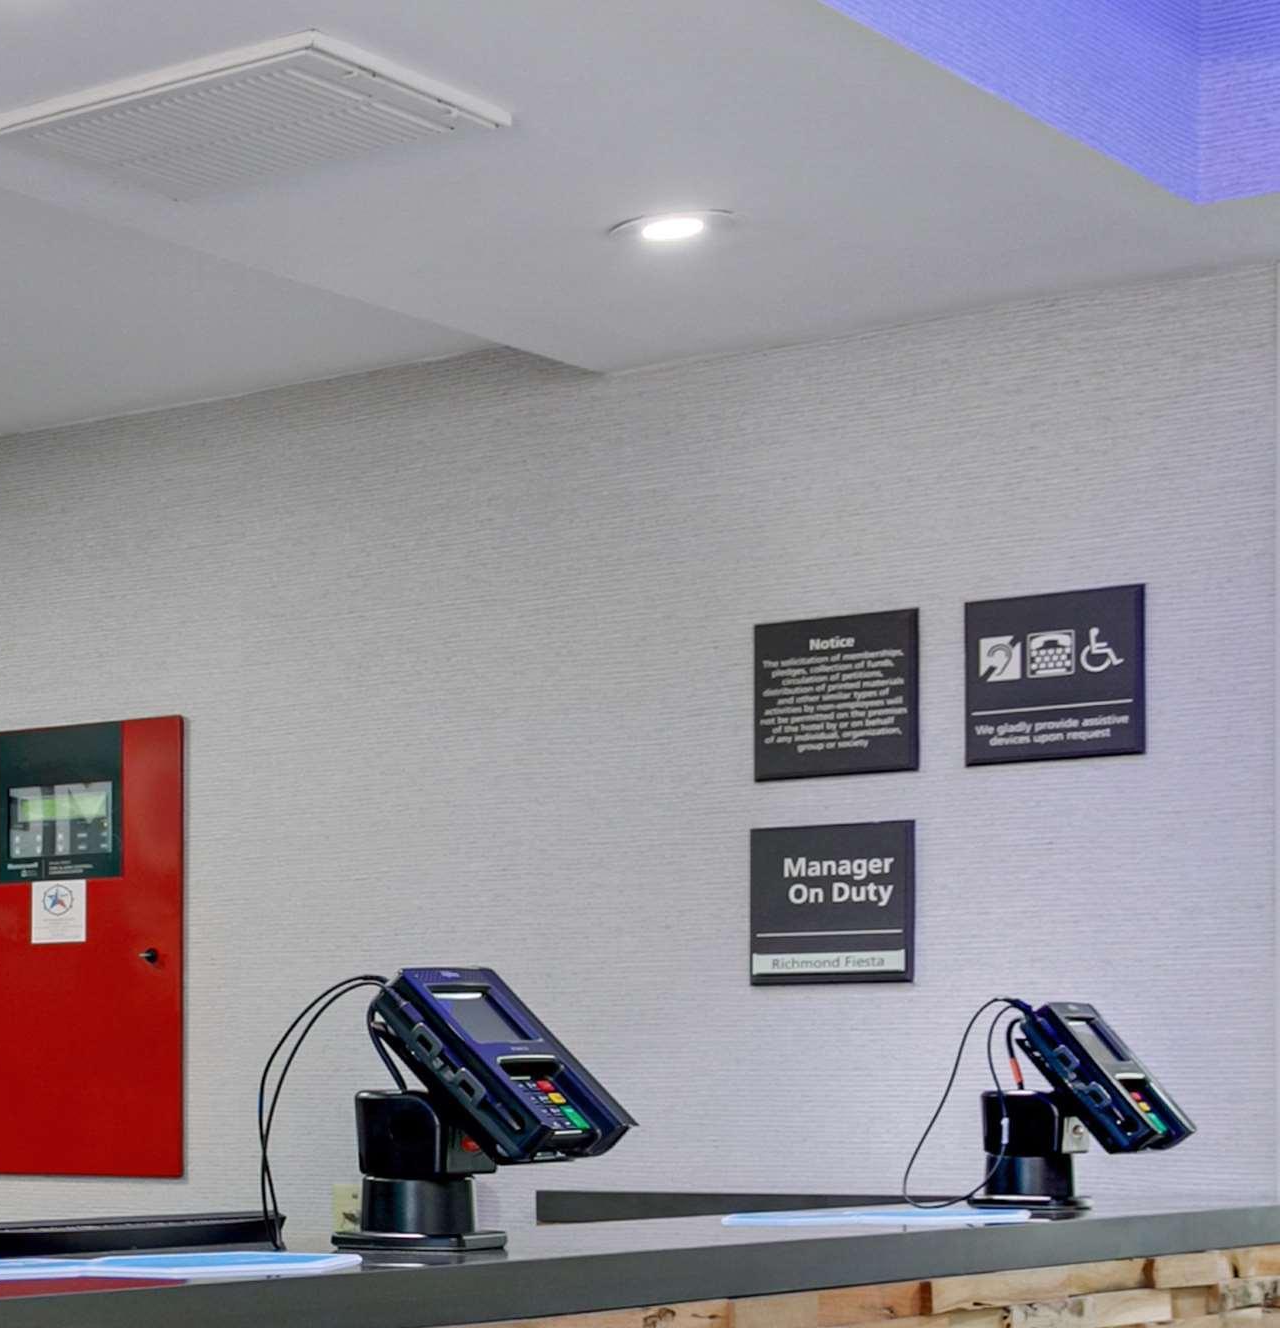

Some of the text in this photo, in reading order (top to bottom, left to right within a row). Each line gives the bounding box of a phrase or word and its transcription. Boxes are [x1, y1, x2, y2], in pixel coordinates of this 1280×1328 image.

[809, 636, 855, 651] Notice
[975, 714, 1129, 735] We gladly provide assistive
[989, 728, 1111, 746] devices upon request
[783, 857, 894, 880] Manager
[788, 882, 894, 906] On Duty
[772, 956, 885, 970] Richmond Fiesta
